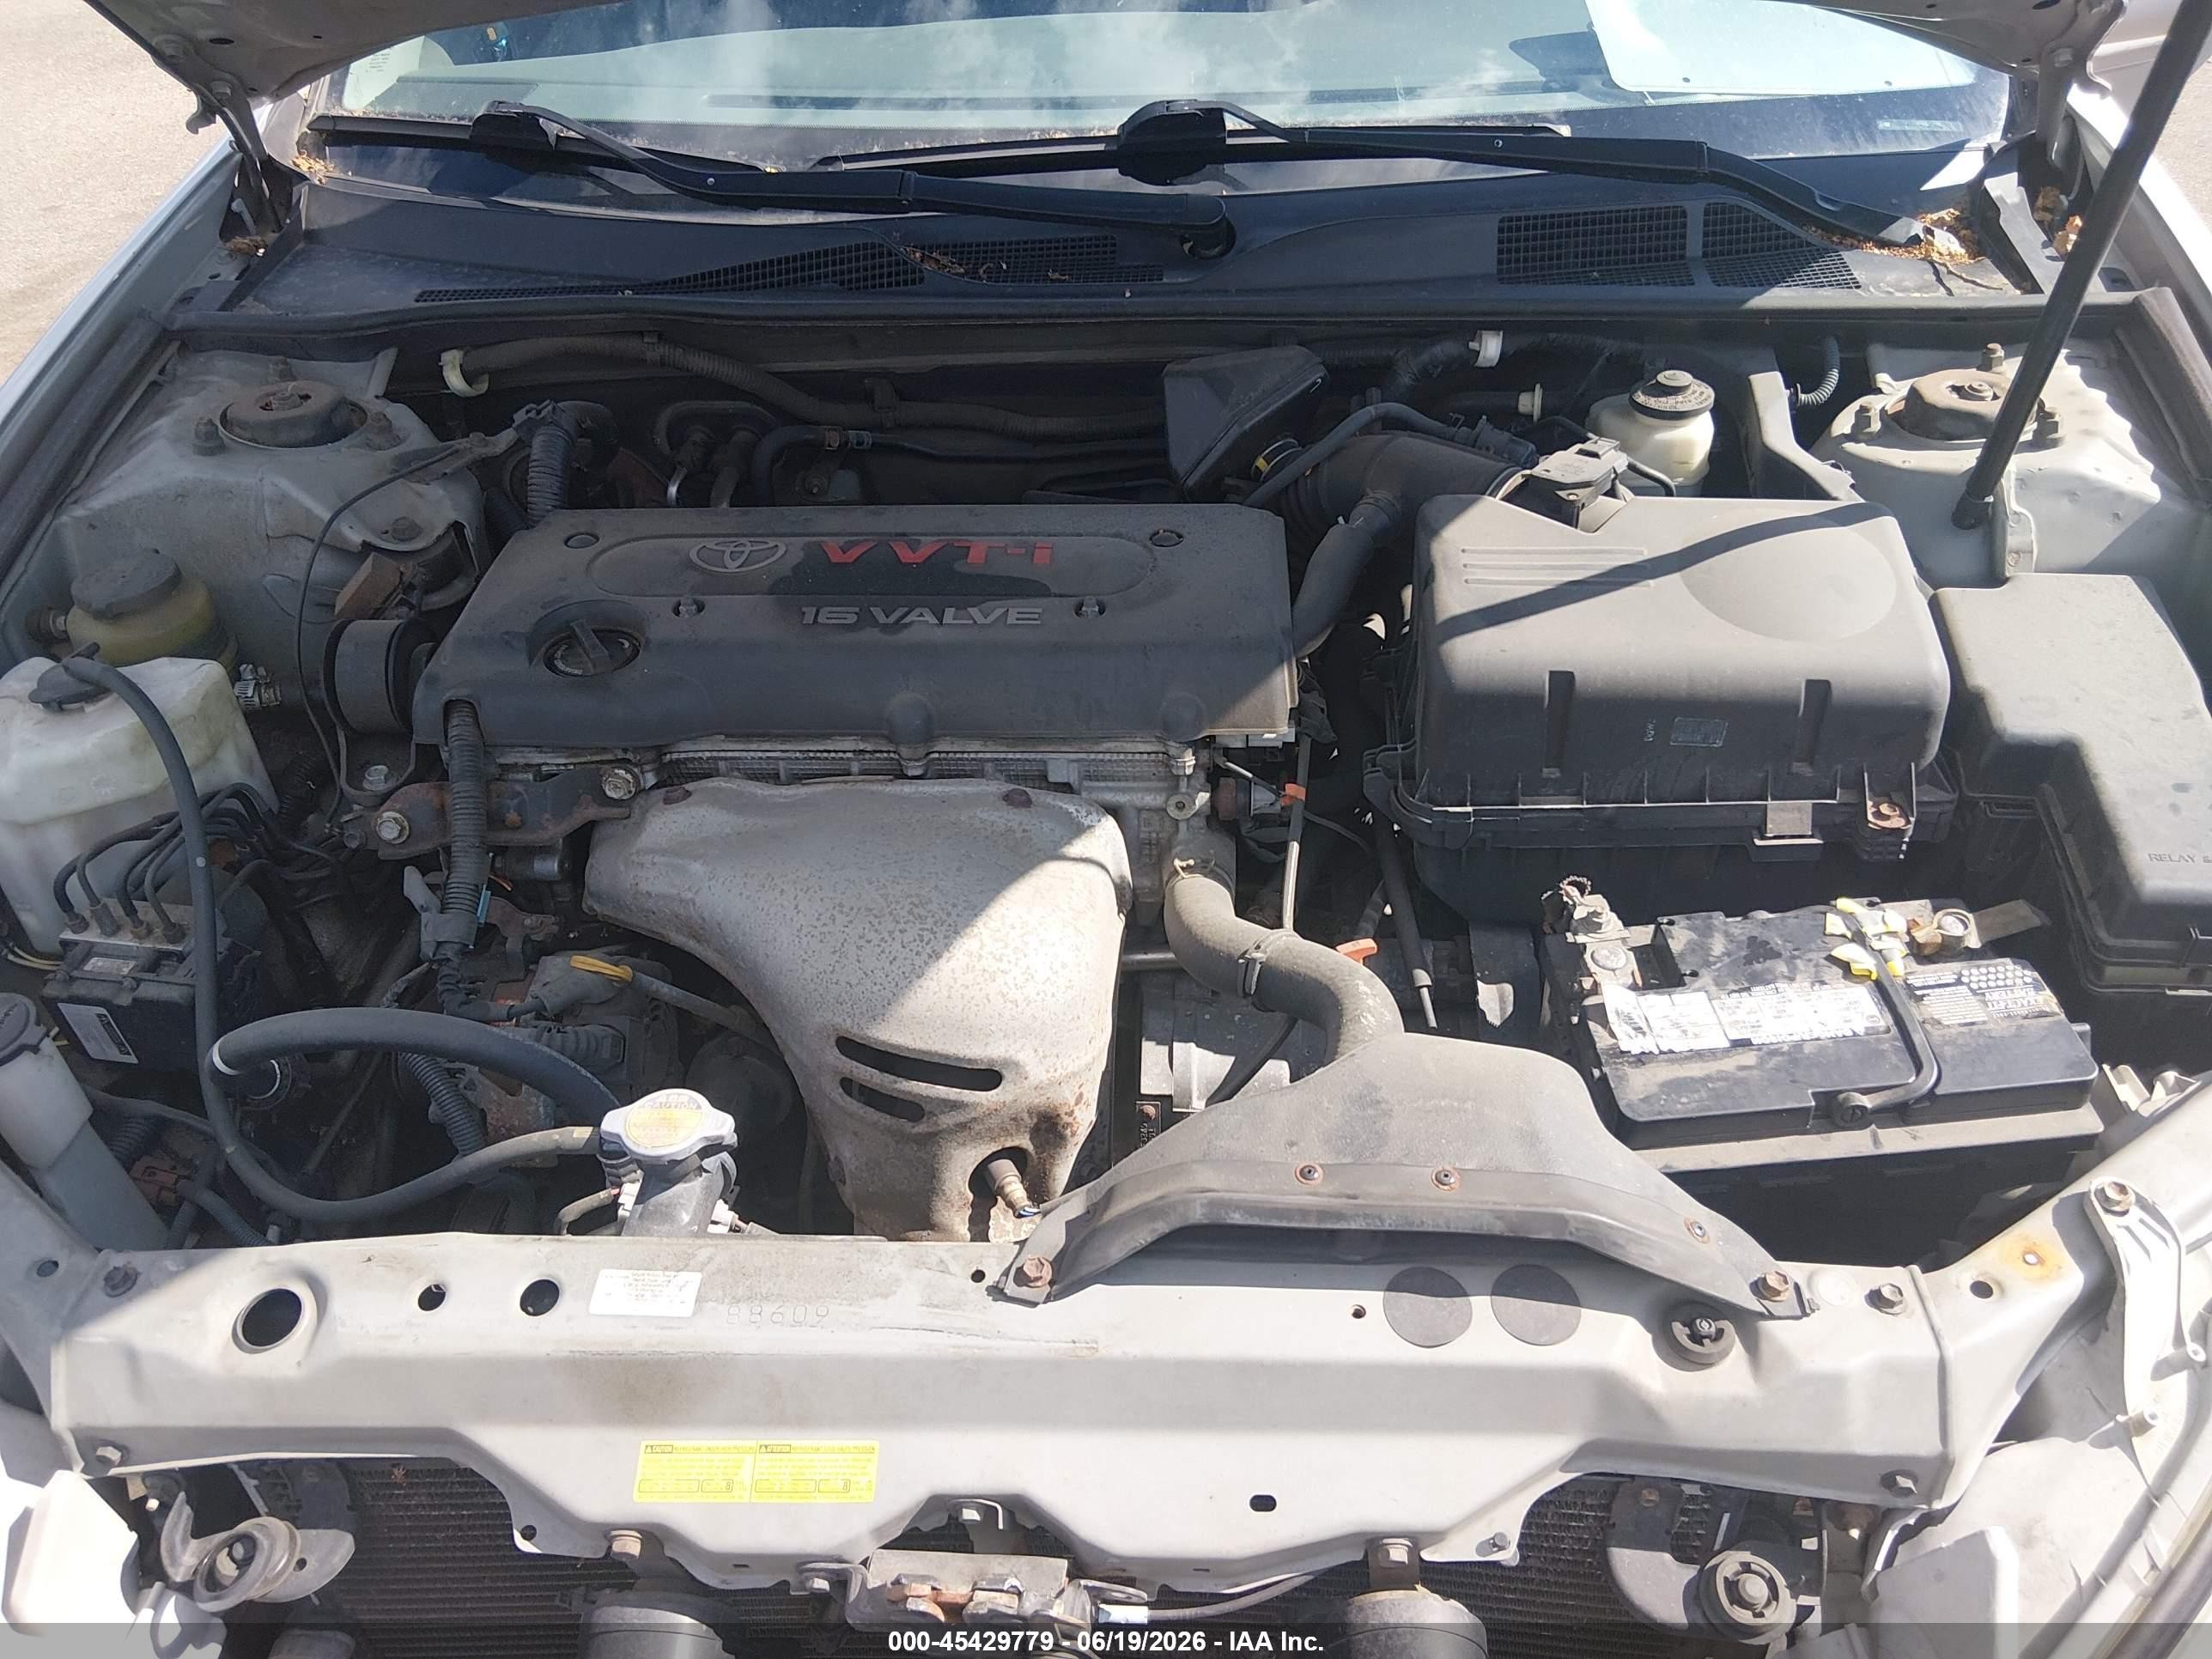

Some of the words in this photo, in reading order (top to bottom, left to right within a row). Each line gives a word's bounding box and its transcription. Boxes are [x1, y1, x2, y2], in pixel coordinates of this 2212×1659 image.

[802, 606, 859, 625] 16
[869, 606, 1043, 625] VALVE
[2148, 853, 2197, 864] RELAY
[726, 1304, 830, 1323] 88609
